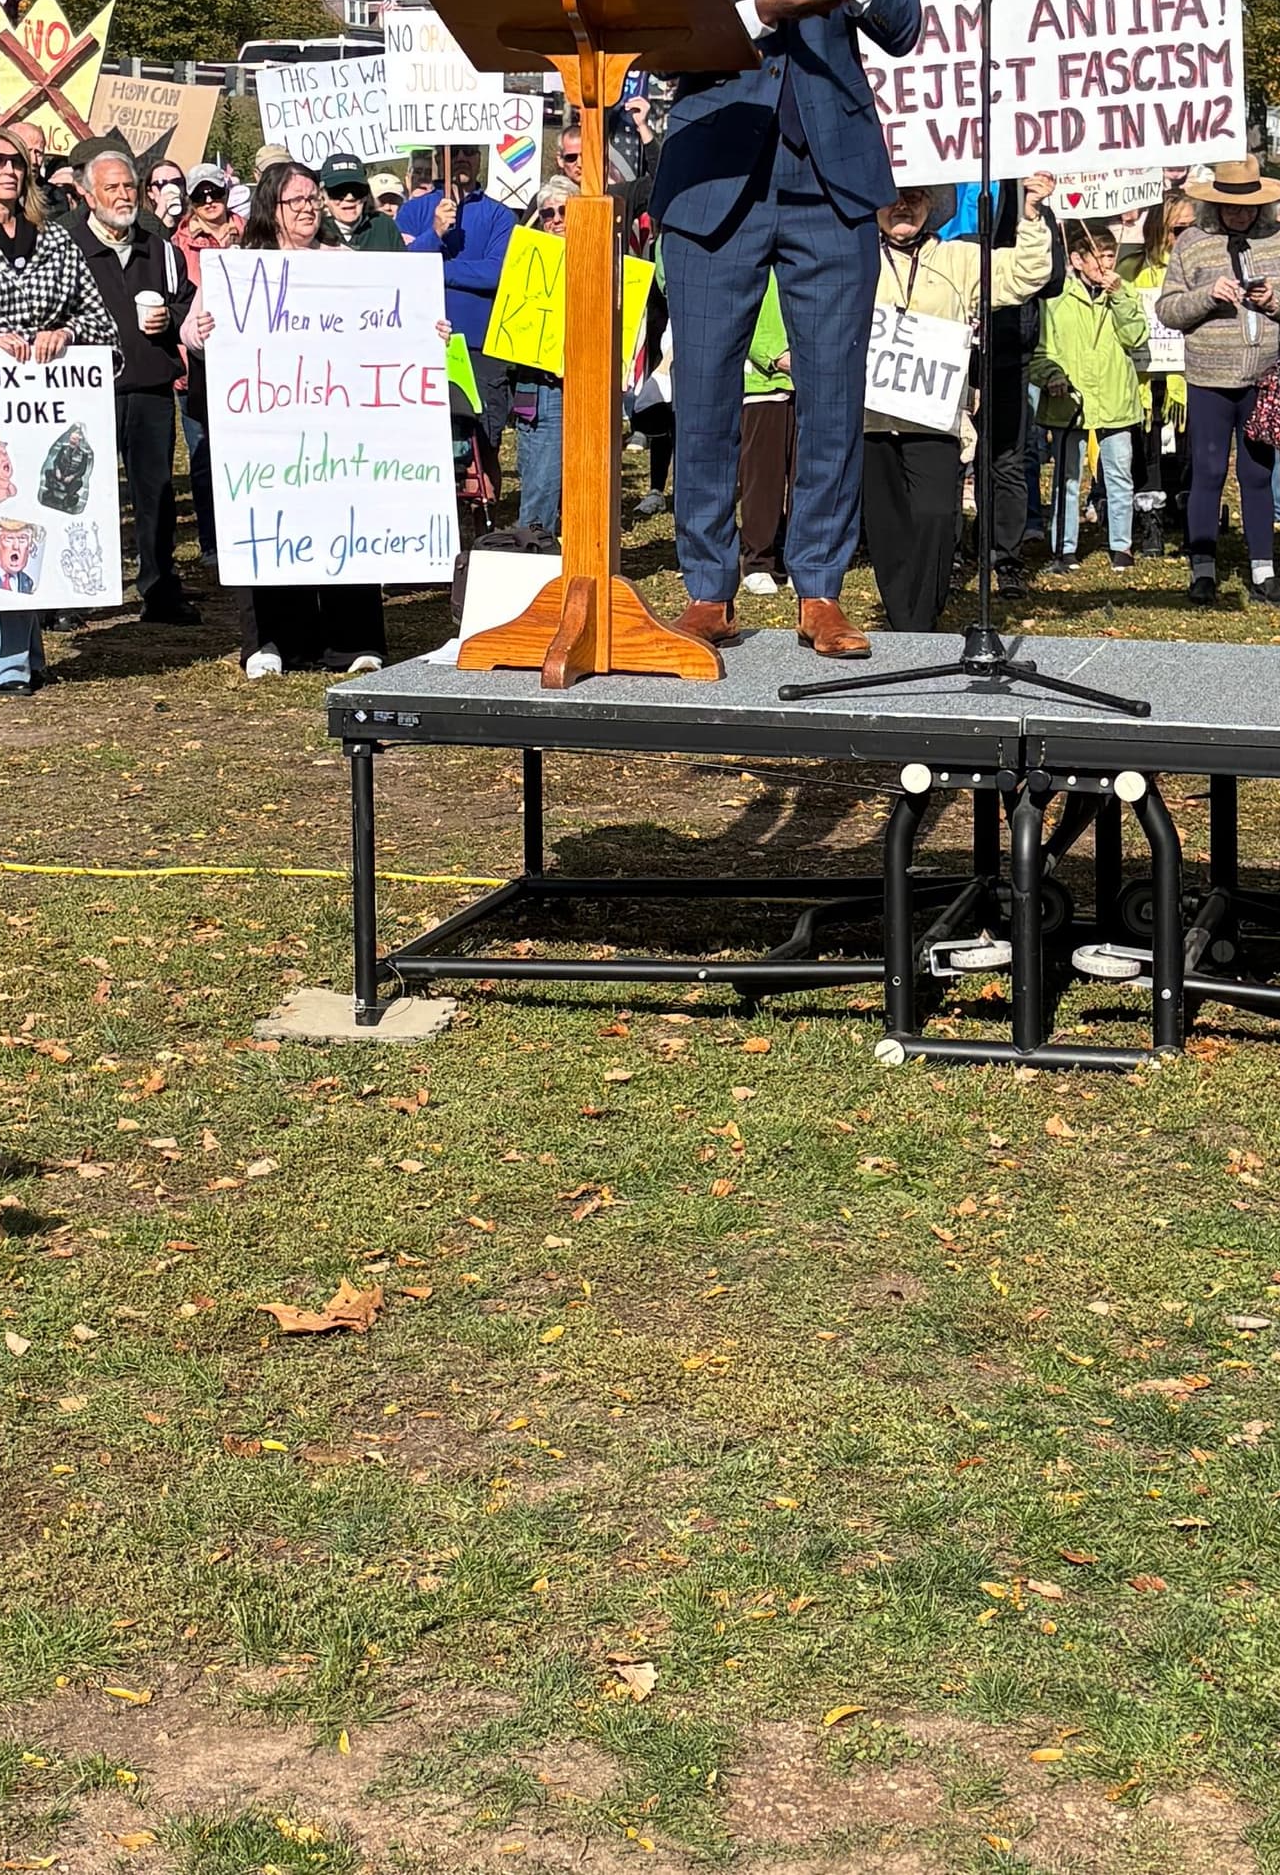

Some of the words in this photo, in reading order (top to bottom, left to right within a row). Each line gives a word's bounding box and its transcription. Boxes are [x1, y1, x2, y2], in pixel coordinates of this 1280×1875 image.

[23, 19, 70, 60] NO
[388, 24, 412, 52] NO
[915, 4, 987, 55] AM
[112, 81, 148, 101] HOW
[151, 86, 181, 106] CAN
[278, 67, 318, 94] THIS
[331, 65, 350, 87] IS
[358, 59, 384, 85] WH
[406, 62, 478, 93] JULIUS
[865, 57, 1036, 114] REJECT
[1059, 39, 1233, 100] FASCISM
[107, 104, 142, 126] YOU
[266, 89, 387, 129] DEMOCRAC
[388, 104, 435, 133] LITTLE
[440, 103, 501, 132] CAESAR
[1015, 108, 1085, 156] DID
[1098, 104, 1145, 150] IN
[1154, 95, 1236, 146] WW2
[284, 128, 354, 162] LOOKS
[1106, 190, 1119, 209] MY
[1123, 181, 1162, 204] COUNTRY
[526, 247, 565, 298] N
[219, 254, 310, 333] When
[320, 313, 343, 333] we
[359, 288, 401, 330] said
[227, 348, 350, 413] abolish
[360, 364, 446, 407] ICE
[870, 348, 961, 400] CENT
[4, 401, 66, 423] JOKE
[373, 458, 440, 483] mean
[234, 507, 314, 579] the
[326, 505, 450, 576] glaciers!!!
